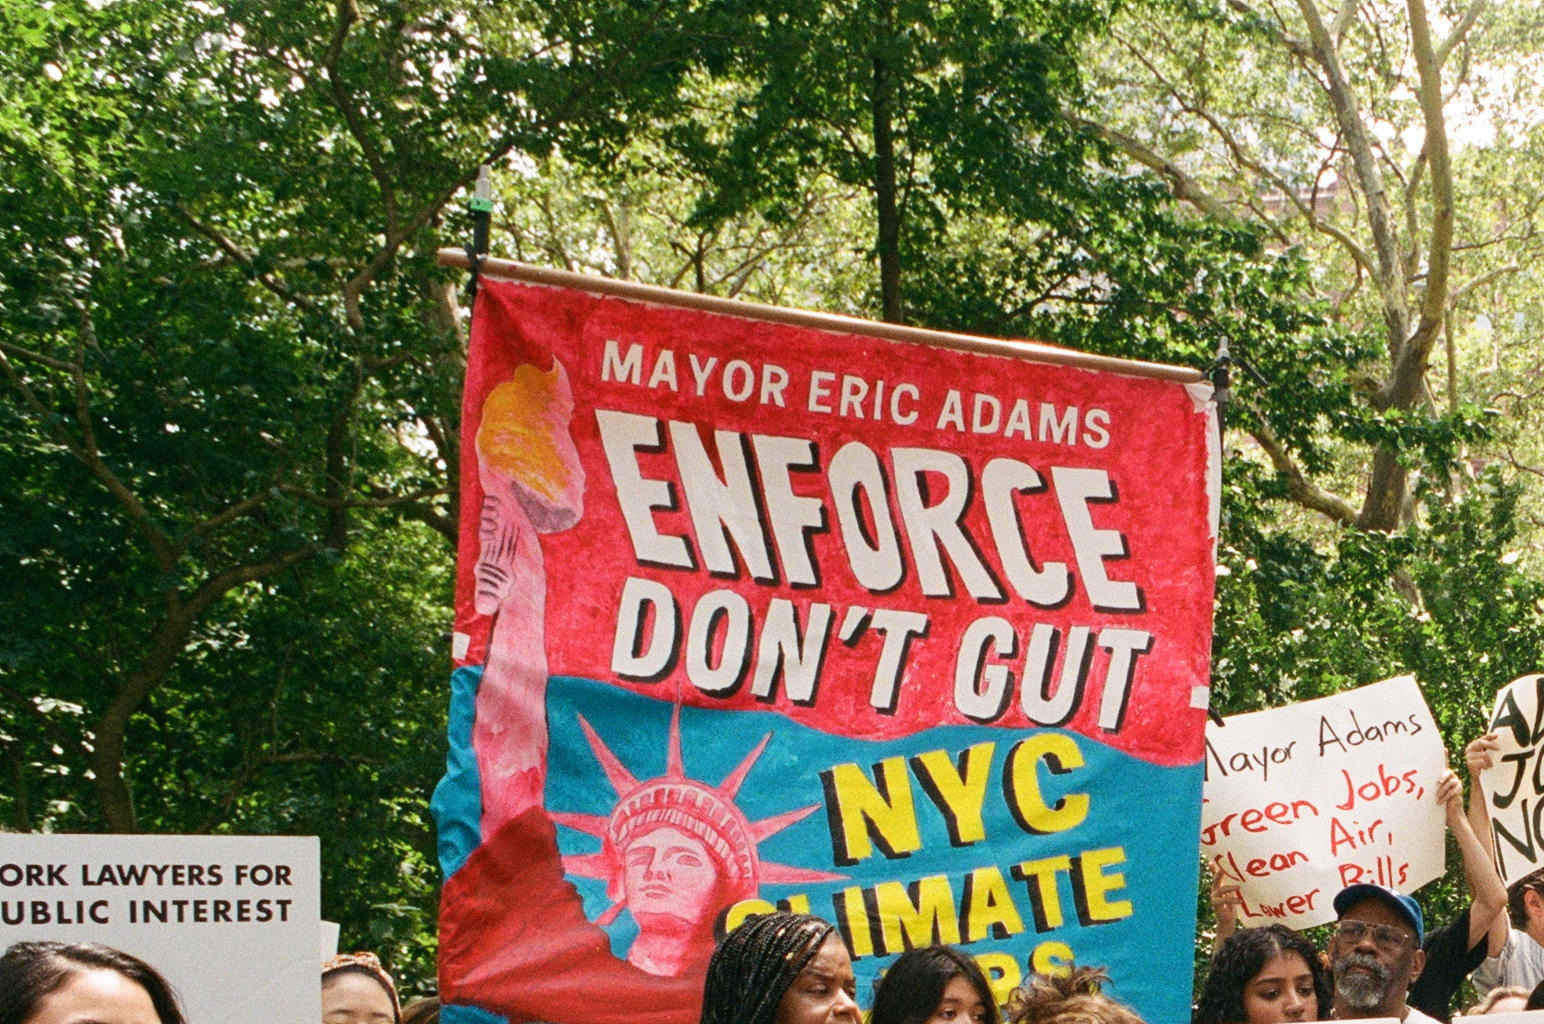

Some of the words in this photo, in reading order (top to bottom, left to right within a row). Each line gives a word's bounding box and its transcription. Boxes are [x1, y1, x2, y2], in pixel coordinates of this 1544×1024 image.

[600, 340, 789, 407] MAYOR
[808, 370, 921, 425] ERIC
[936, 390, 1112, 449] ADAMS
[595, 409, 1148, 613] ENFORCE
[610, 576, 928, 714] DON'T
[953, 617, 1152, 732] GUT
[1319, 709, 1421, 757] Adams
[1337, 764, 1424, 810] Jobs,
[820, 733, 1091, 869] NYC
[0, 864, 69, 886] ORK
[82, 864, 223, 886] LAWYERS
[235, 864, 292, 886] FOR
[1, 899, 109, 925] UBLIC
[129, 898, 292, 923] INTEREST
[718, 847, 1134, 960] IMATE
